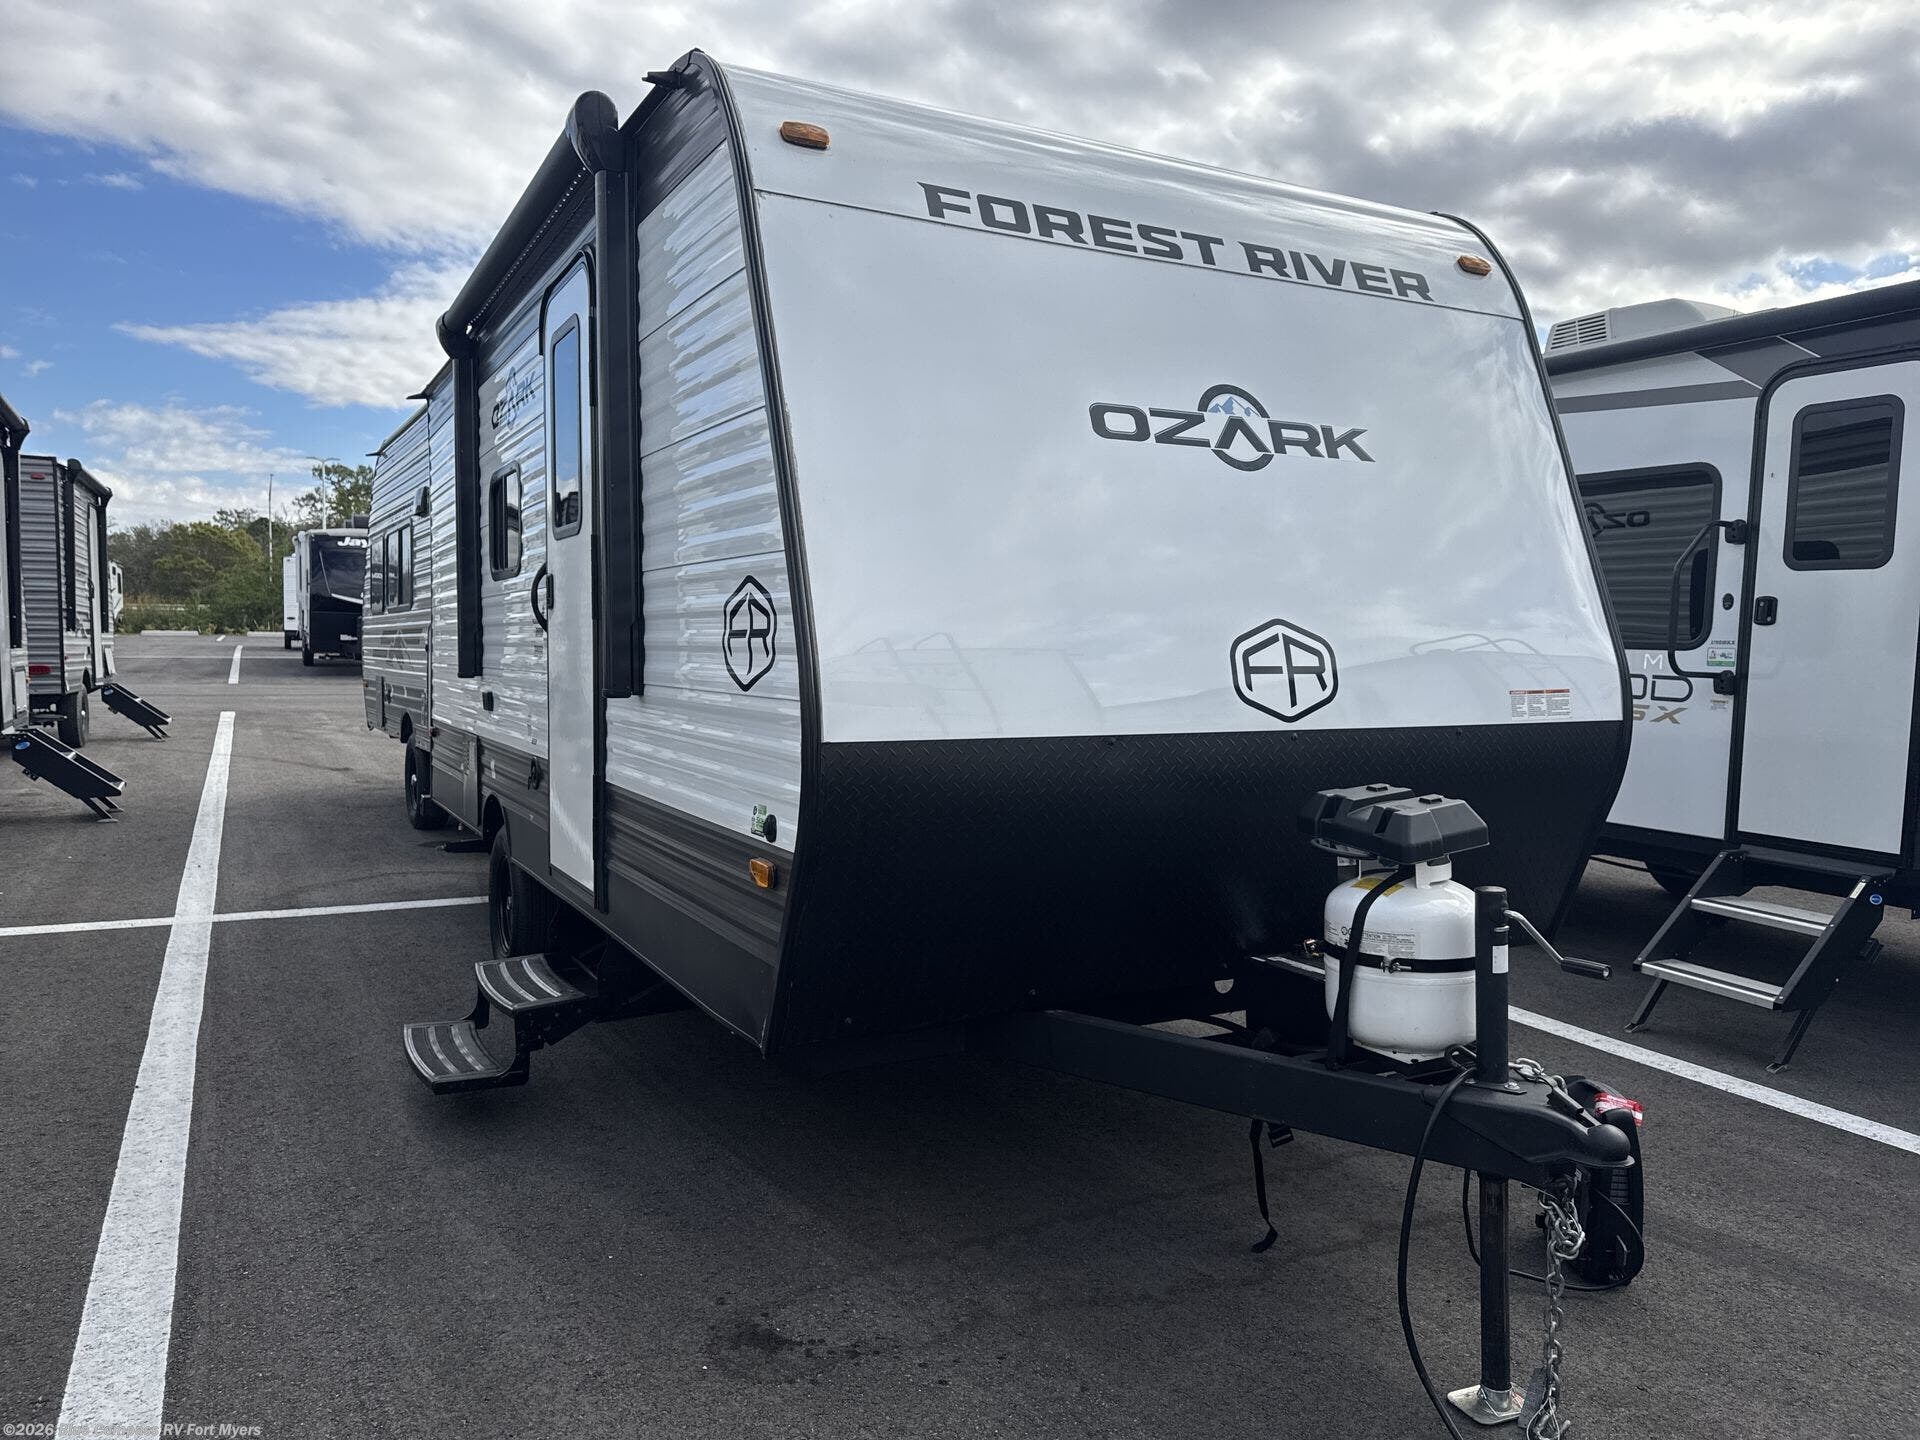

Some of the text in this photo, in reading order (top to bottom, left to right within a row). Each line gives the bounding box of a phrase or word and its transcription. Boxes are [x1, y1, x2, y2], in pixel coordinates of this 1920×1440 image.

[916, 181, 1435, 302] FOREST RIVER
[1088, 401, 1377, 463] OZARK
[1242, 633, 1327, 708] FR
